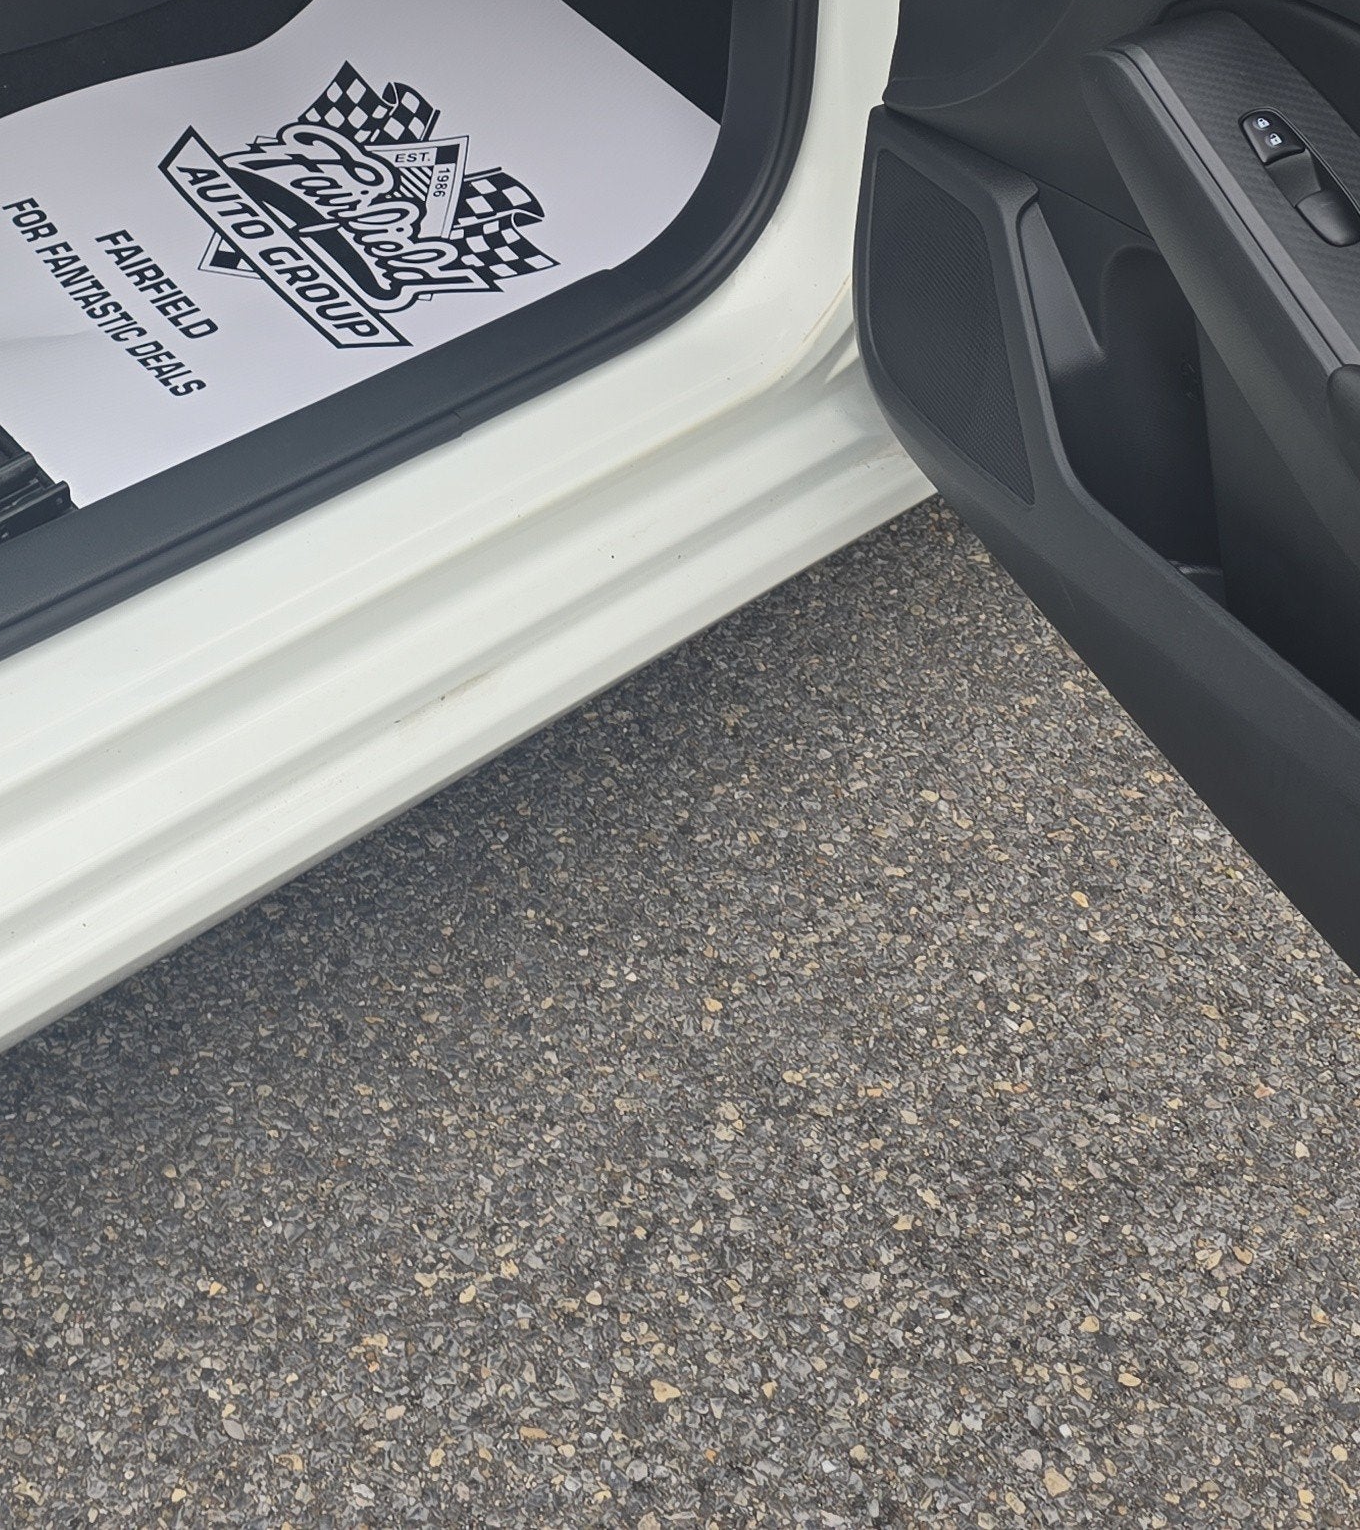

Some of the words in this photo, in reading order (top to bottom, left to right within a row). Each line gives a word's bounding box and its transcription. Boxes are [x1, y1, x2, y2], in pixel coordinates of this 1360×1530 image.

[235, 128, 478, 294] Fairfield
[394, 151, 431, 163] EST.
[433, 167, 451, 198] 1986
[2, 197, 58, 243] FOR
[35, 241, 148, 343] FANTASTIC
[125, 340, 207, 397] DEALS
[95, 229, 219, 340] FAIRFIELD
[176, 166, 275, 240] AUTO
[258, 246, 380, 339] GROUP
